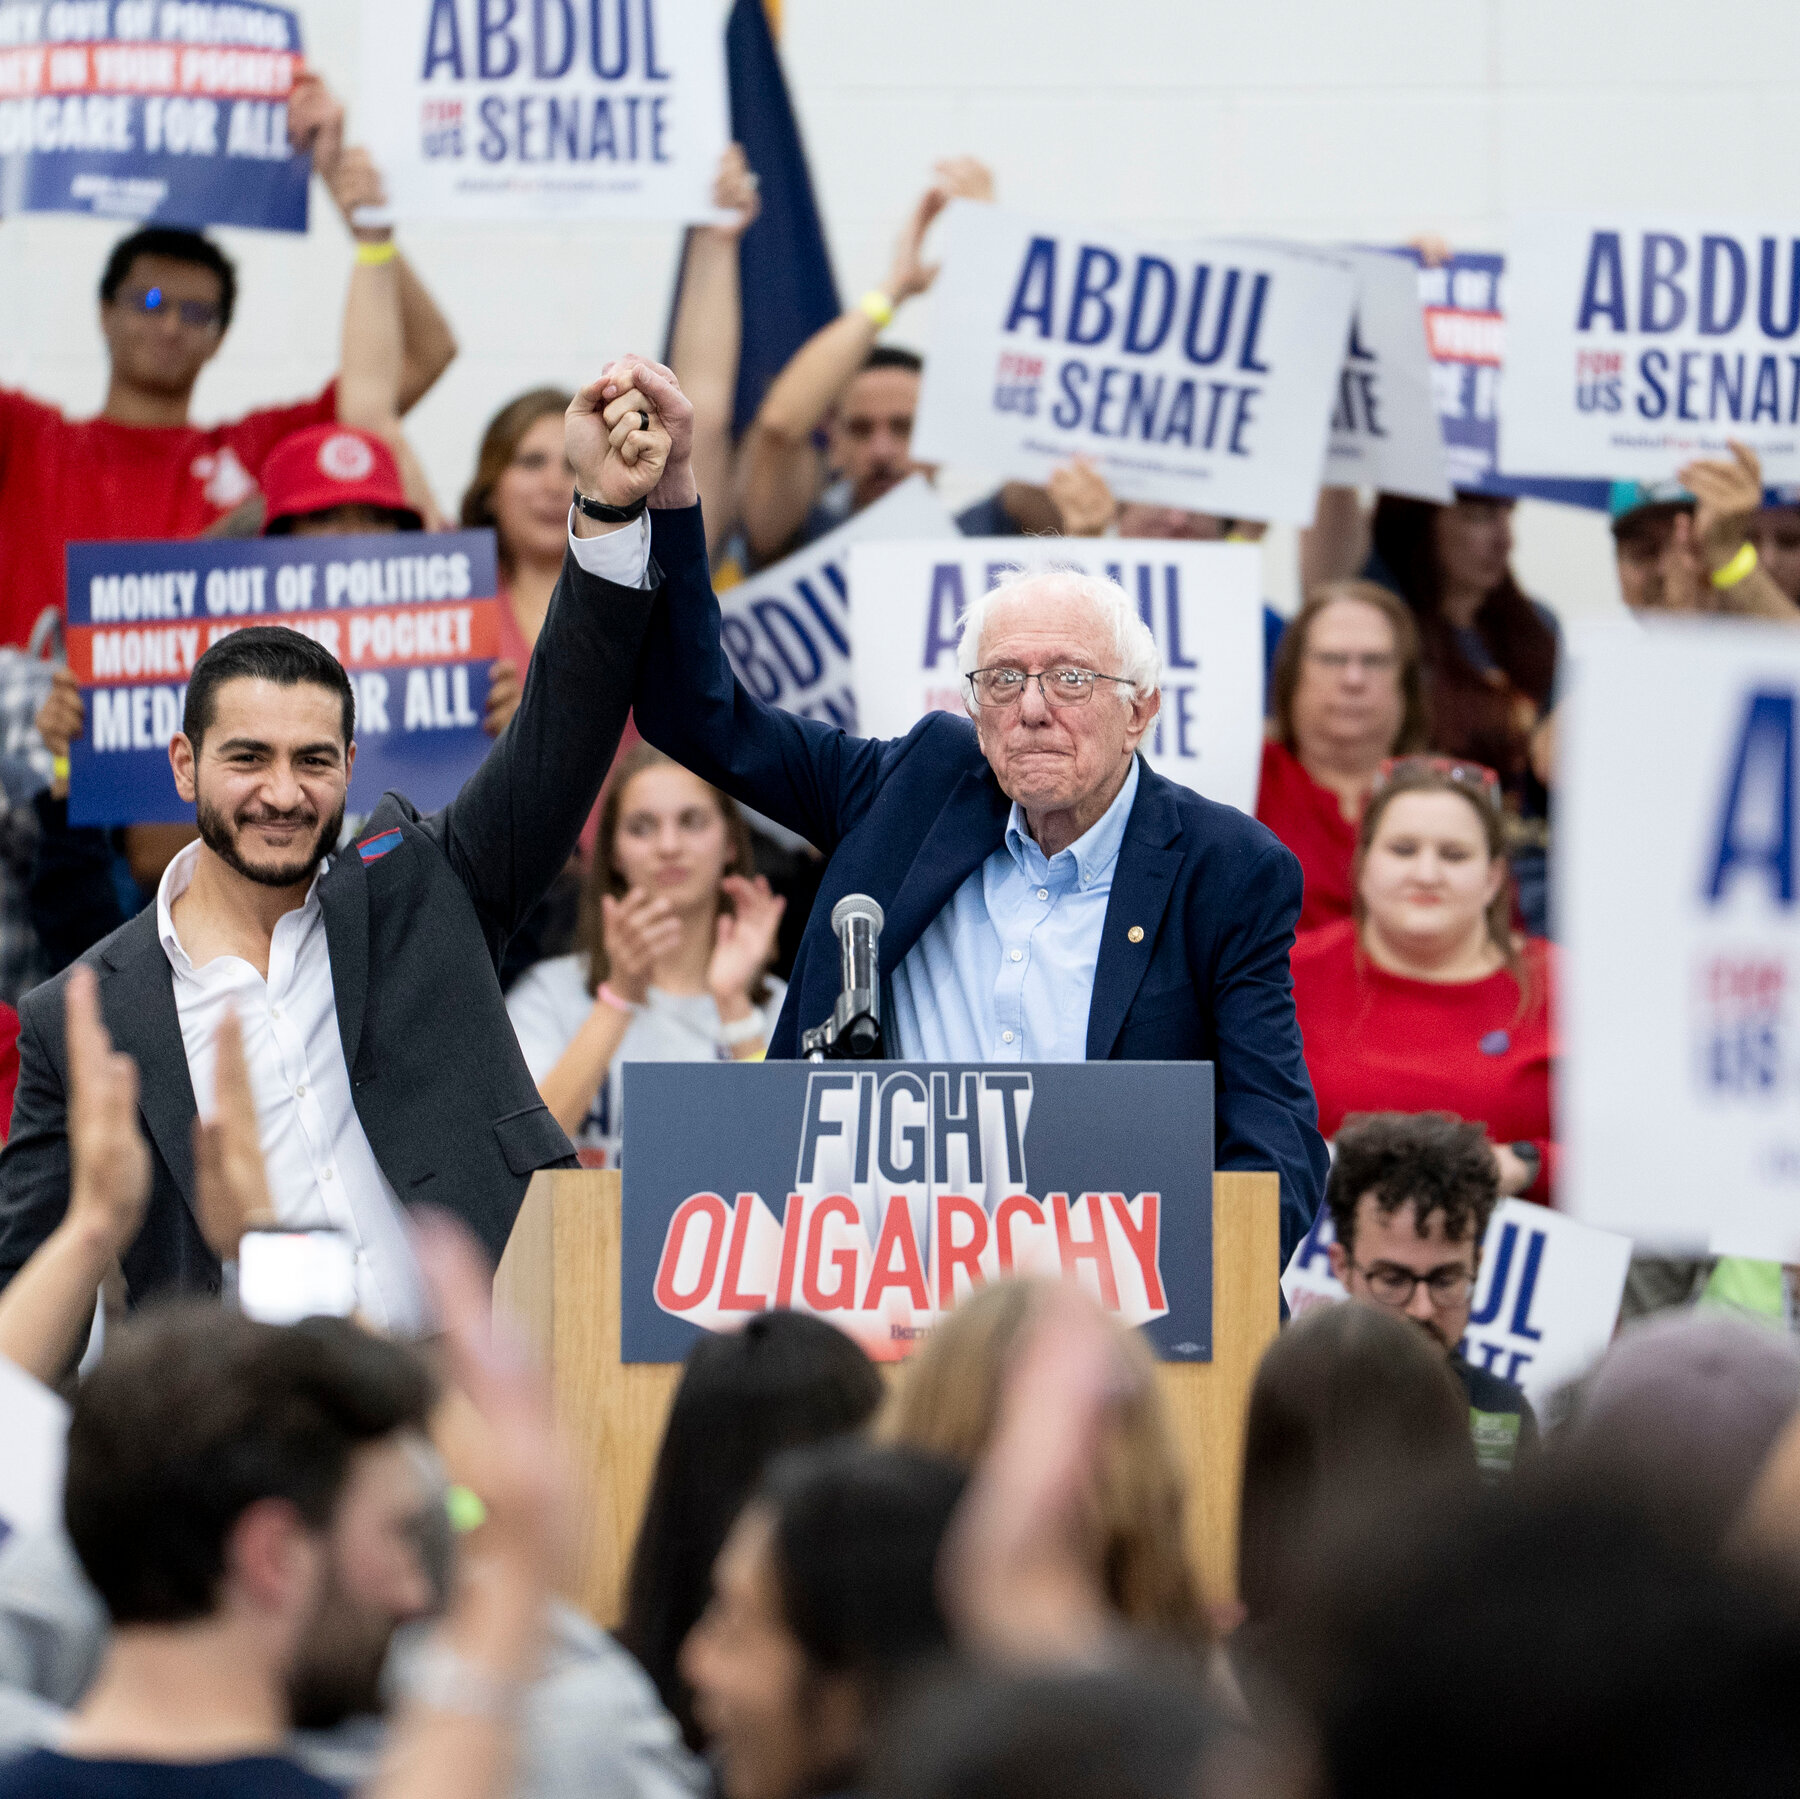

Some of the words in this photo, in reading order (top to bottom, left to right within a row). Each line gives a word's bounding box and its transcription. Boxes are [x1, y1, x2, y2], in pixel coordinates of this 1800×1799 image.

[422, 0, 670, 81] ABDUL
[478, 96, 672, 164] SENATE
[1004, 235, 1271, 374] ABDUL
[1052, 360, 1264, 456] SENATE
[90, 573, 196, 620] MONEY
[205, 567, 268, 614] OUT
[276, 564, 318, 611] OF
[326, 553, 470, 607] POLITICS
[91, 628, 196, 677] MONEY
[350, 609, 473, 660] POCKET
[404, 666, 476, 731] ALL
[796, 1071, 1033, 1185] FIGHT
[654, 1193, 1170, 1312] OLIGARCHY
